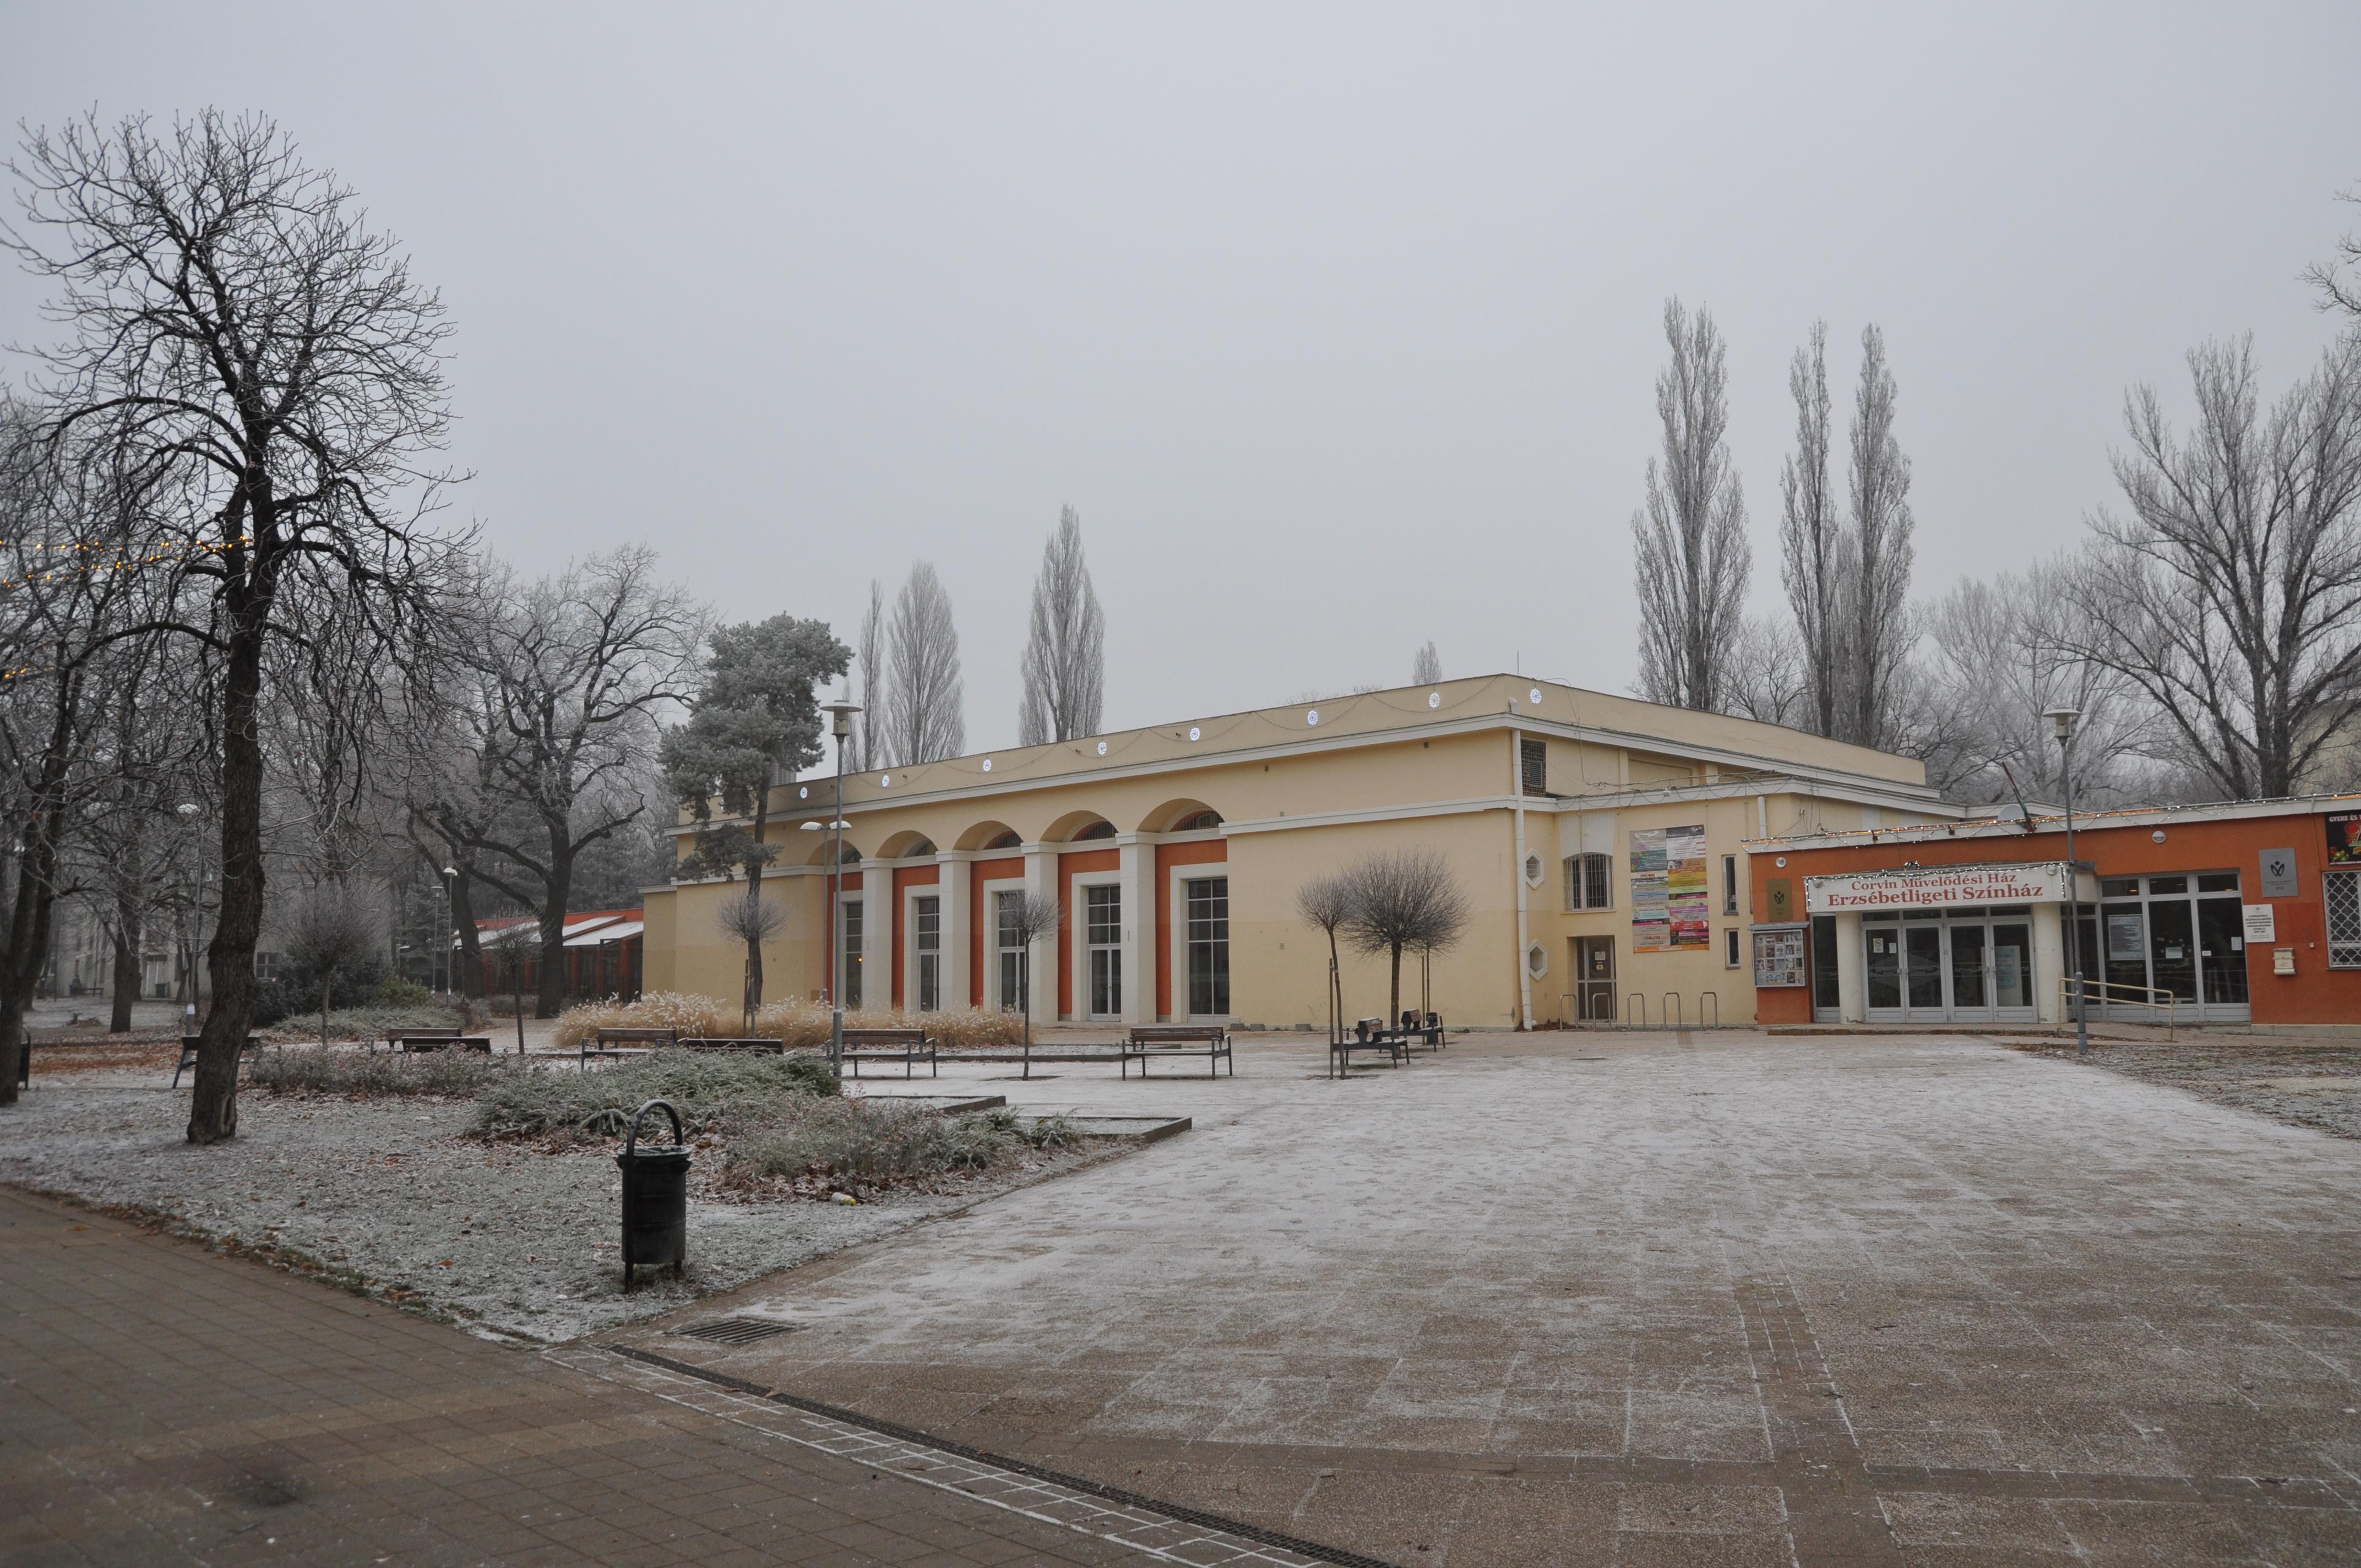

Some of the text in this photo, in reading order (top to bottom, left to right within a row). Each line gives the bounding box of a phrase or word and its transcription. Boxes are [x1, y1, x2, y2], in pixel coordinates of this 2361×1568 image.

[1852, 873, 2017, 890] Corvin Művelődési Ház
[1828, 884, 2043, 906] Erzsébetligeti Színház
